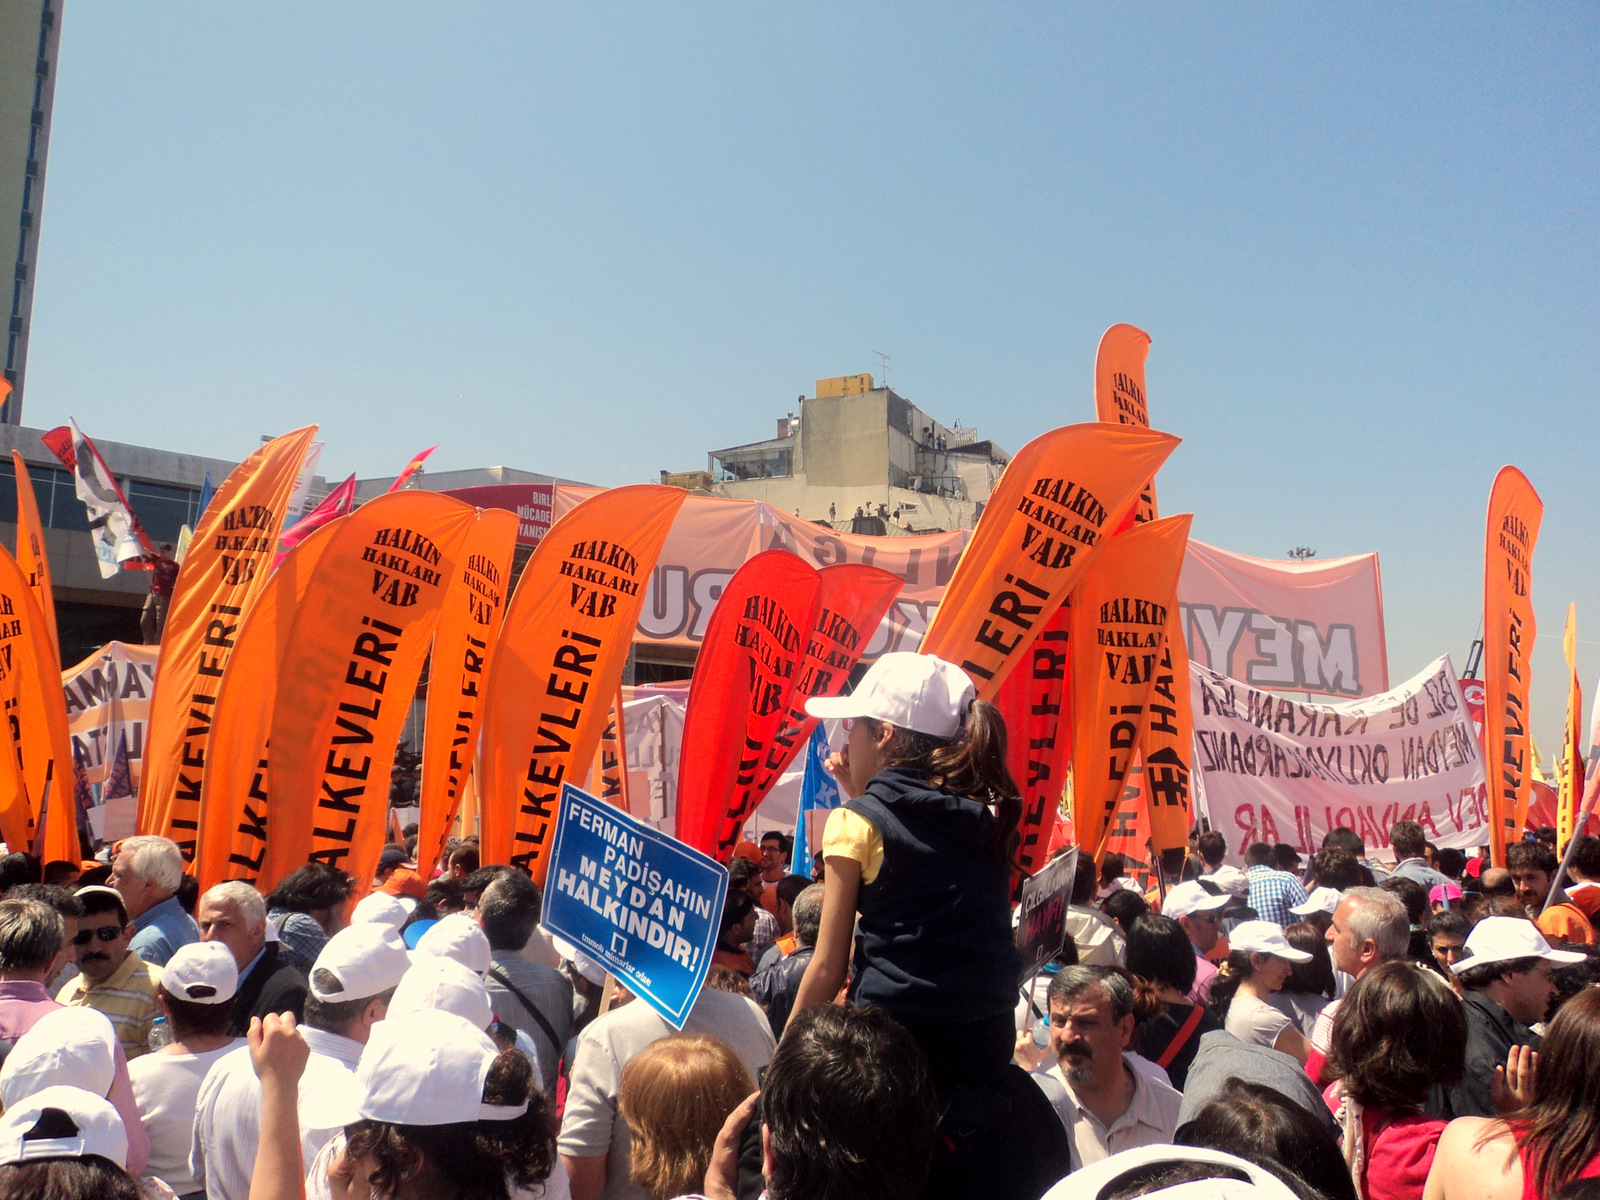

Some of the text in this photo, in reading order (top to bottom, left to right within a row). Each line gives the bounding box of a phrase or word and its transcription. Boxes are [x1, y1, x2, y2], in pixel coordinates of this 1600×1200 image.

[1031, 478, 1107, 528] HALKIN
[361, 546, 442, 587] HAKLARI
[373, 527, 442, 567] HALKIN
[570, 540, 639, 577] HALKIN
[559, 561, 640, 597] HAKLARI
[568, 802, 644, 860] FERMAN
[579, 855, 685, 932] MEYDAN
[604, 845, 711, 919] PADİŞAHIN
[557, 868, 700, 973] HALKINDIR!
